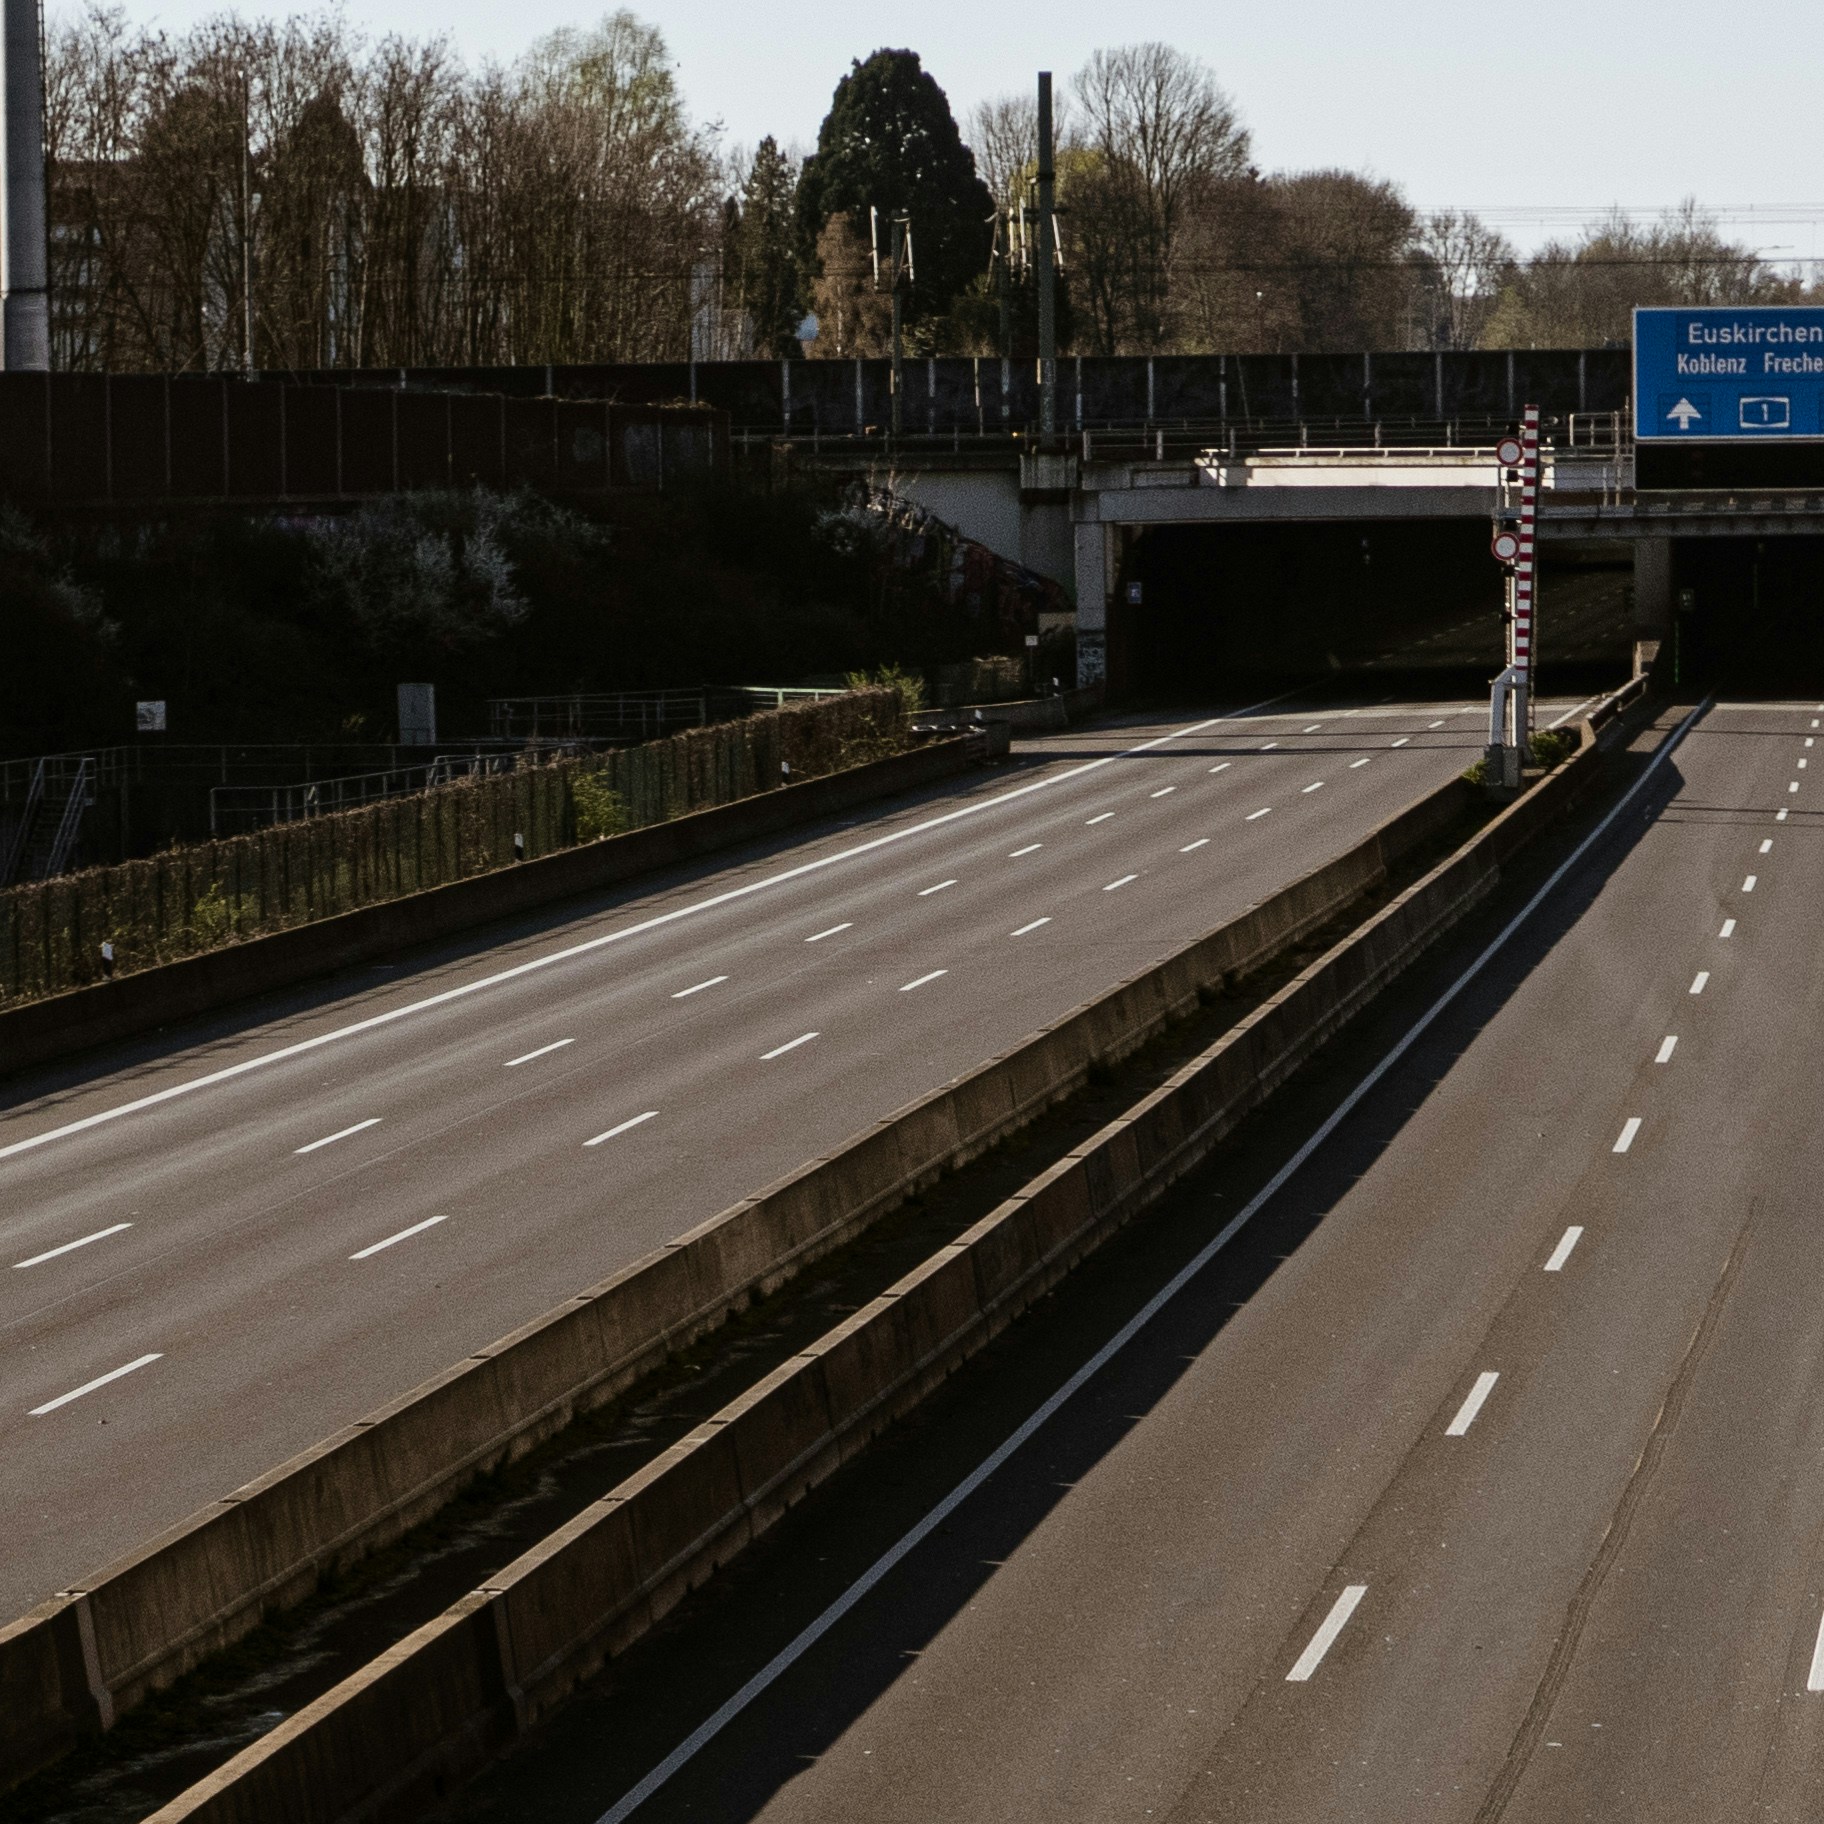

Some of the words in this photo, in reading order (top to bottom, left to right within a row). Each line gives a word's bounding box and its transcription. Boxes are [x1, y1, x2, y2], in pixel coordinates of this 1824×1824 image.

[1688, 322, 1823, 344] Euskirchen
[1677, 352, 1746, 374] Koblenz
[1760, 403, 1769, 421] 1
